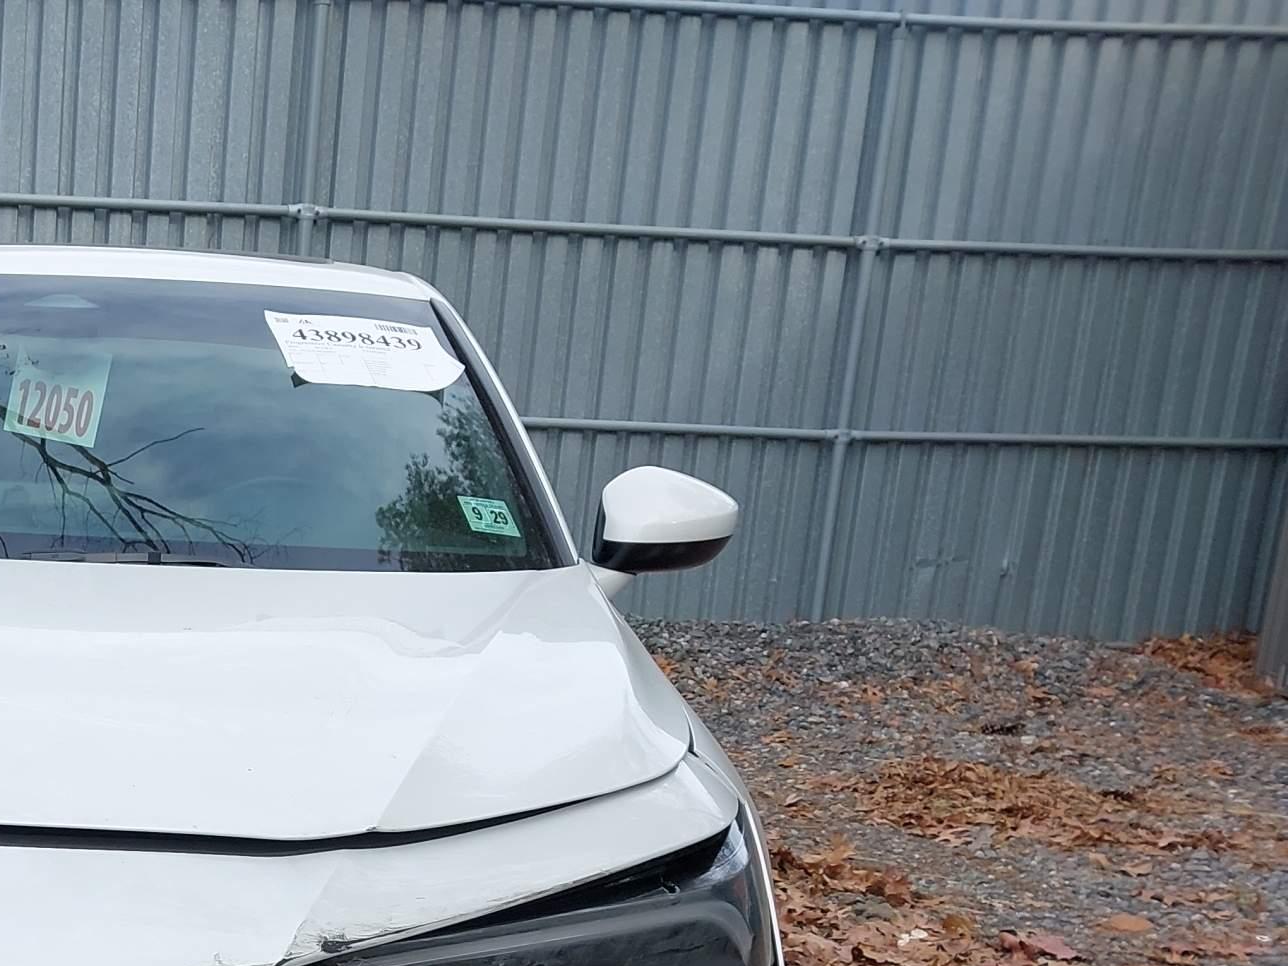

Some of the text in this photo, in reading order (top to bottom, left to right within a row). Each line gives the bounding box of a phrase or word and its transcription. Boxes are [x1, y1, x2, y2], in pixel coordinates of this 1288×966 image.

[292, 328, 423, 351] 43898439
[17, 379, 94, 437] 12050
[472, 506, 509, 526] 9 29
